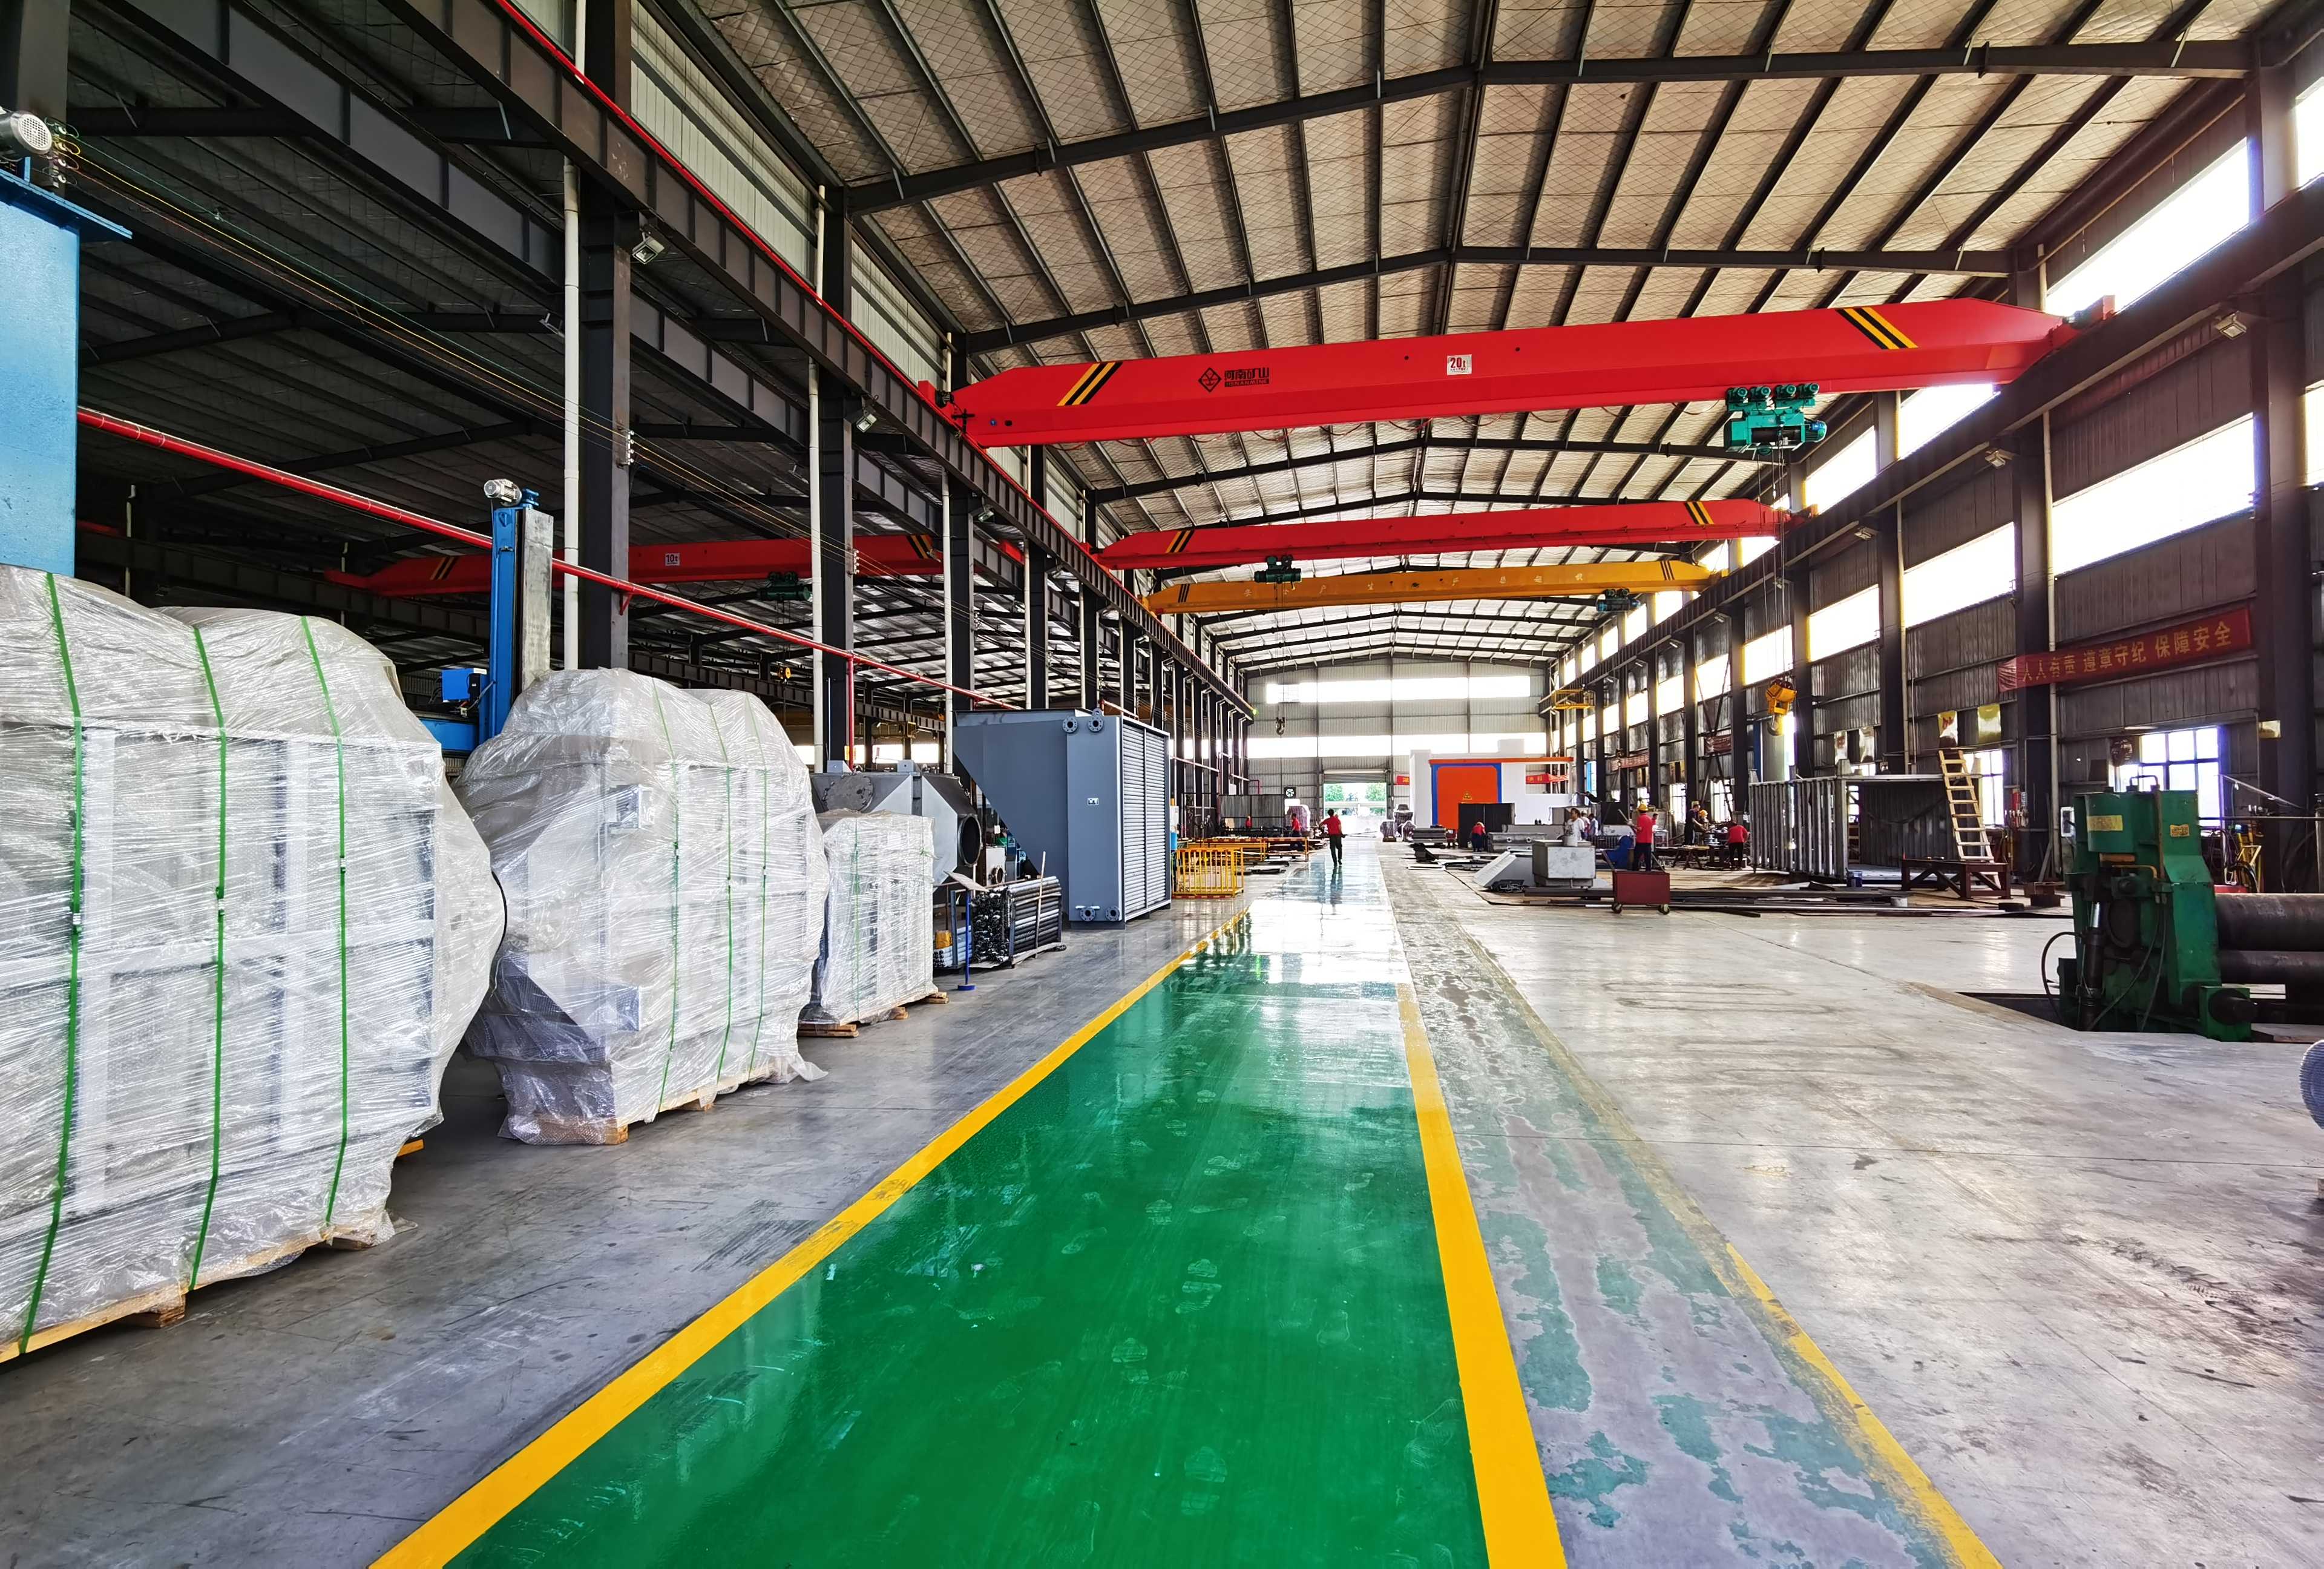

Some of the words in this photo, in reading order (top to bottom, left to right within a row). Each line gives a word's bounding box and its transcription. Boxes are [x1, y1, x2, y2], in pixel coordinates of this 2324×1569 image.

[666, 554, 678, 562] 10t
[2082, 640, 2147, 673] 遵章守纪
[2155, 620, 2232, 659] 保障安全
